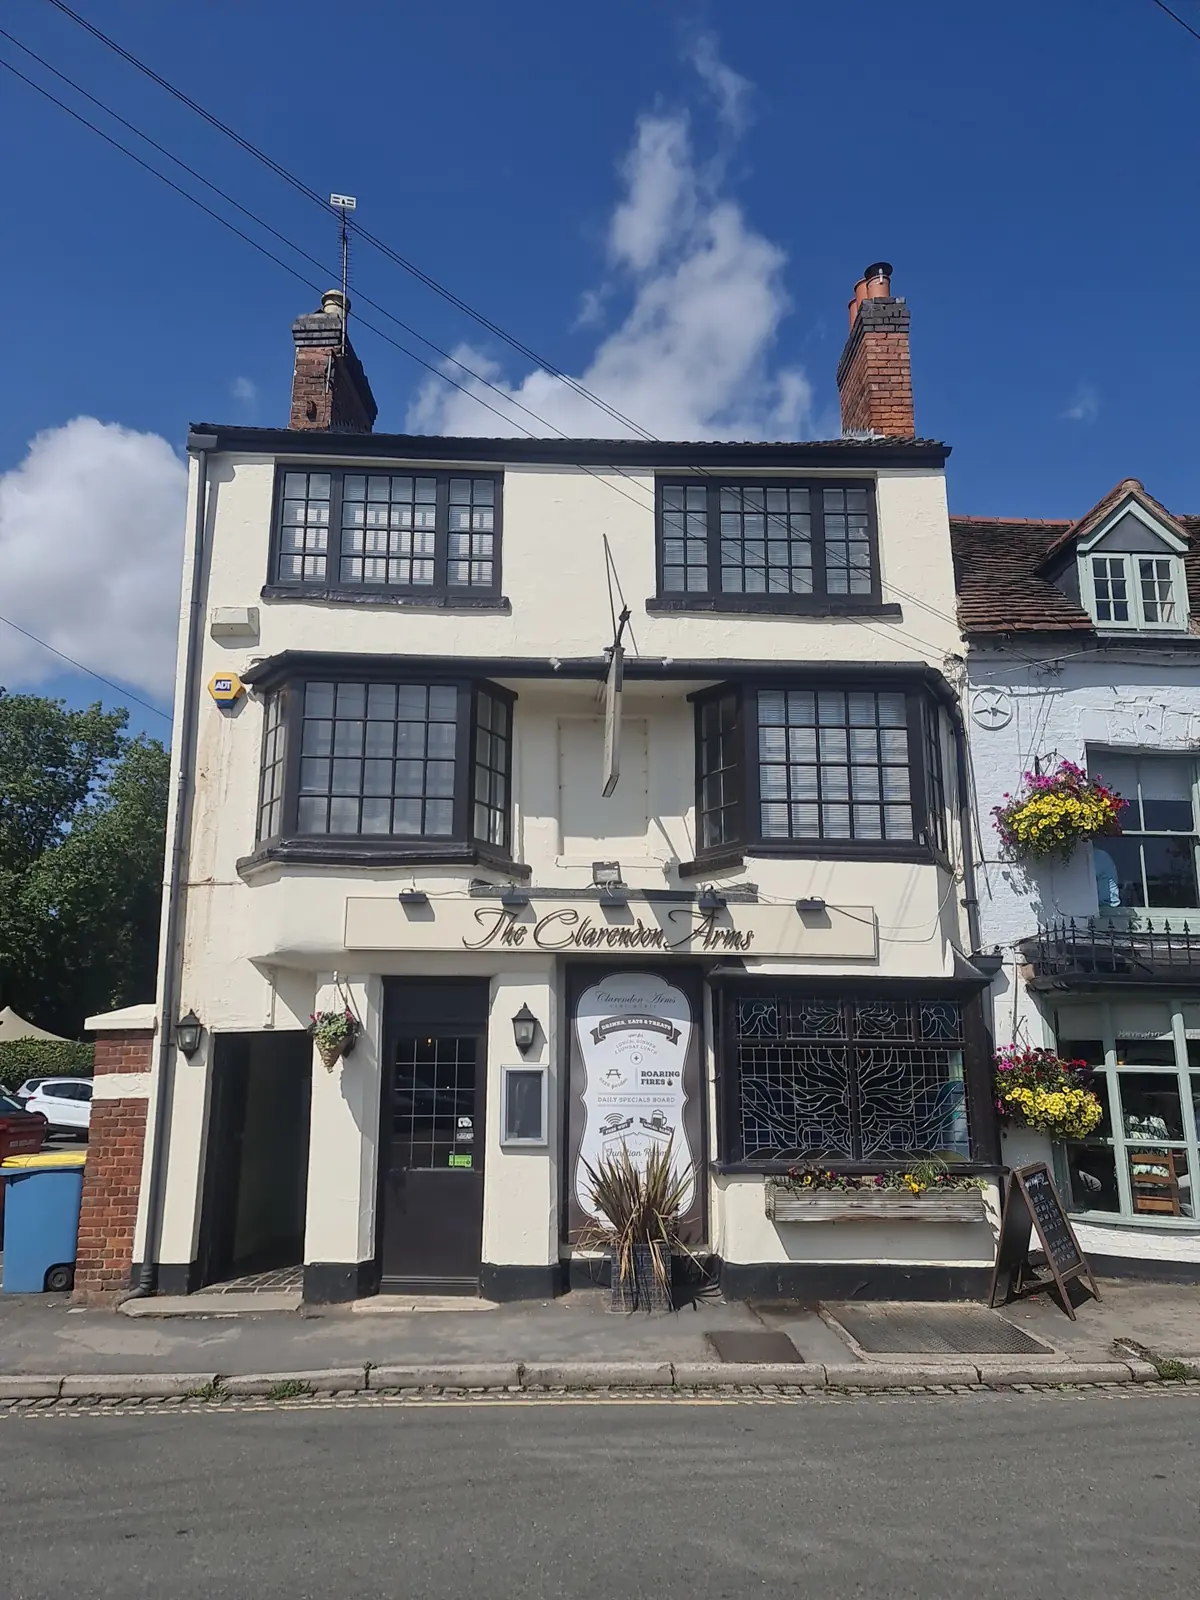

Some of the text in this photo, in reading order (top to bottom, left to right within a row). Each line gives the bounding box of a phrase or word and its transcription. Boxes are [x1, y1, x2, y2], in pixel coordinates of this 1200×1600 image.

[215, 681, 232, 690] ADT
[463, 907, 755, 951] The Clarendon Arms
[595, 991, 677, 1004] Clarendon Arms
[649, 1019, 672, 1029] TREATS
